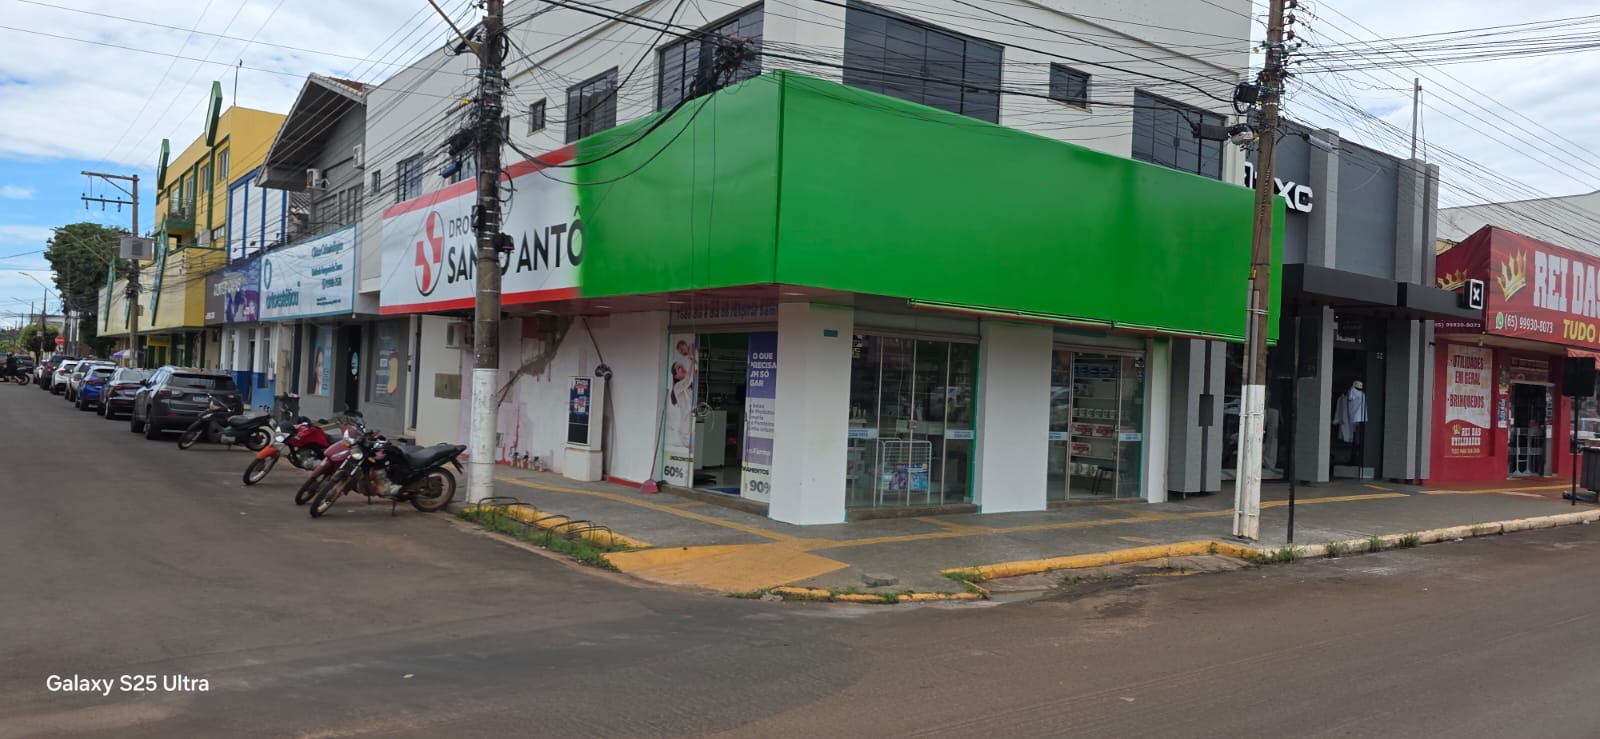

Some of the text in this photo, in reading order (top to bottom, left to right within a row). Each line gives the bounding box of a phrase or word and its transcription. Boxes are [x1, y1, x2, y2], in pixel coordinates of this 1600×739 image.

[1533, 250, 1569, 313] REI
[1472, 287, 1481, 302] X
[1504, 313, 1518, 331] (65)
[1563, 319, 1596, 343] TUDO
[758, 352, 774, 360] QUE
[664, 465, 684, 479] 60%
